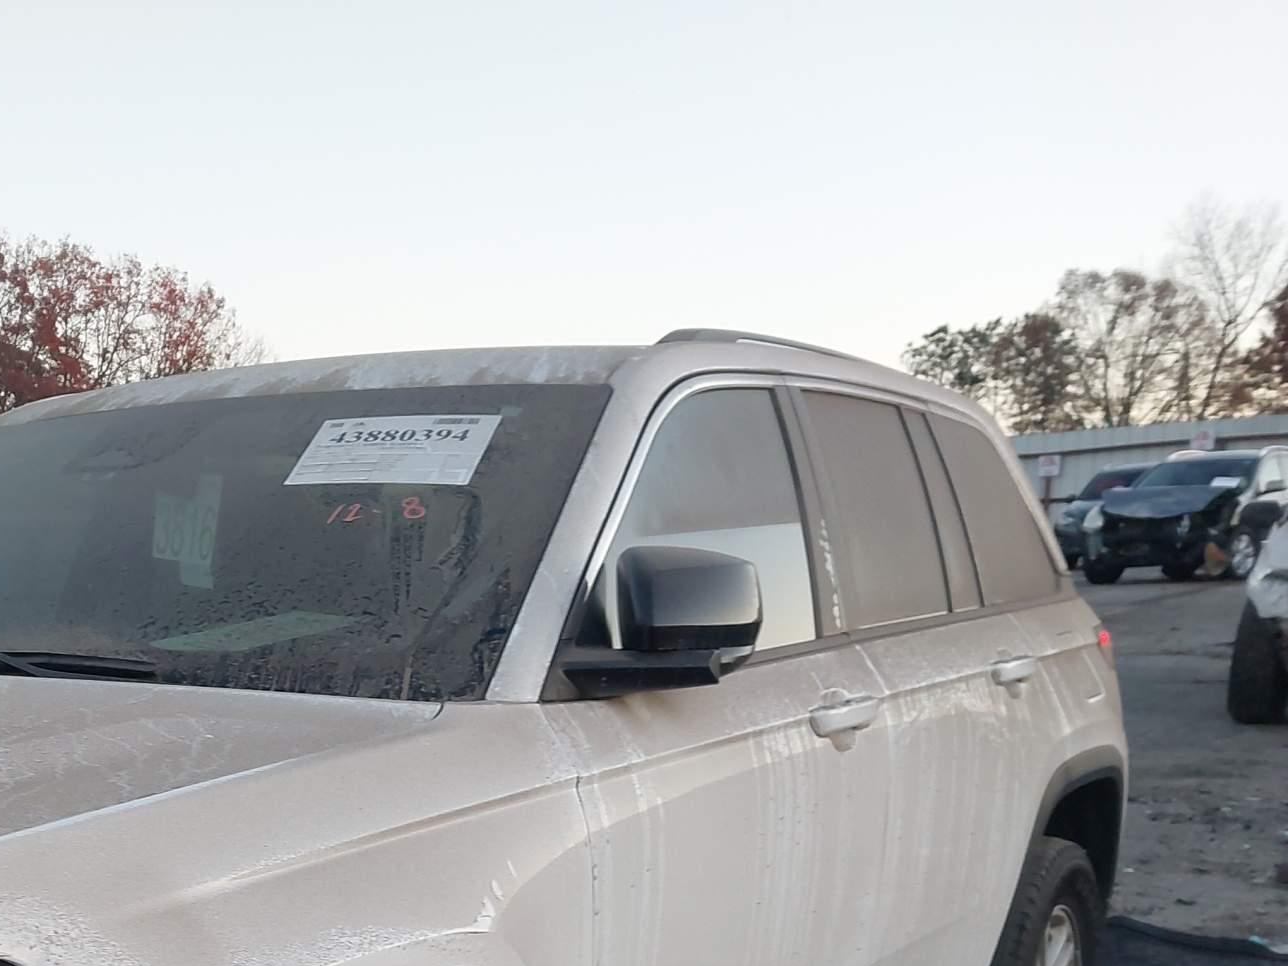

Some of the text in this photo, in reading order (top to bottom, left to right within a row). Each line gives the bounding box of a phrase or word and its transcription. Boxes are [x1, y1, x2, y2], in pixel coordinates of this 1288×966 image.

[328, 428, 471, 444] 43880394
[326, 502, 361, 524] 12
[401, 496, 426, 519] 8
